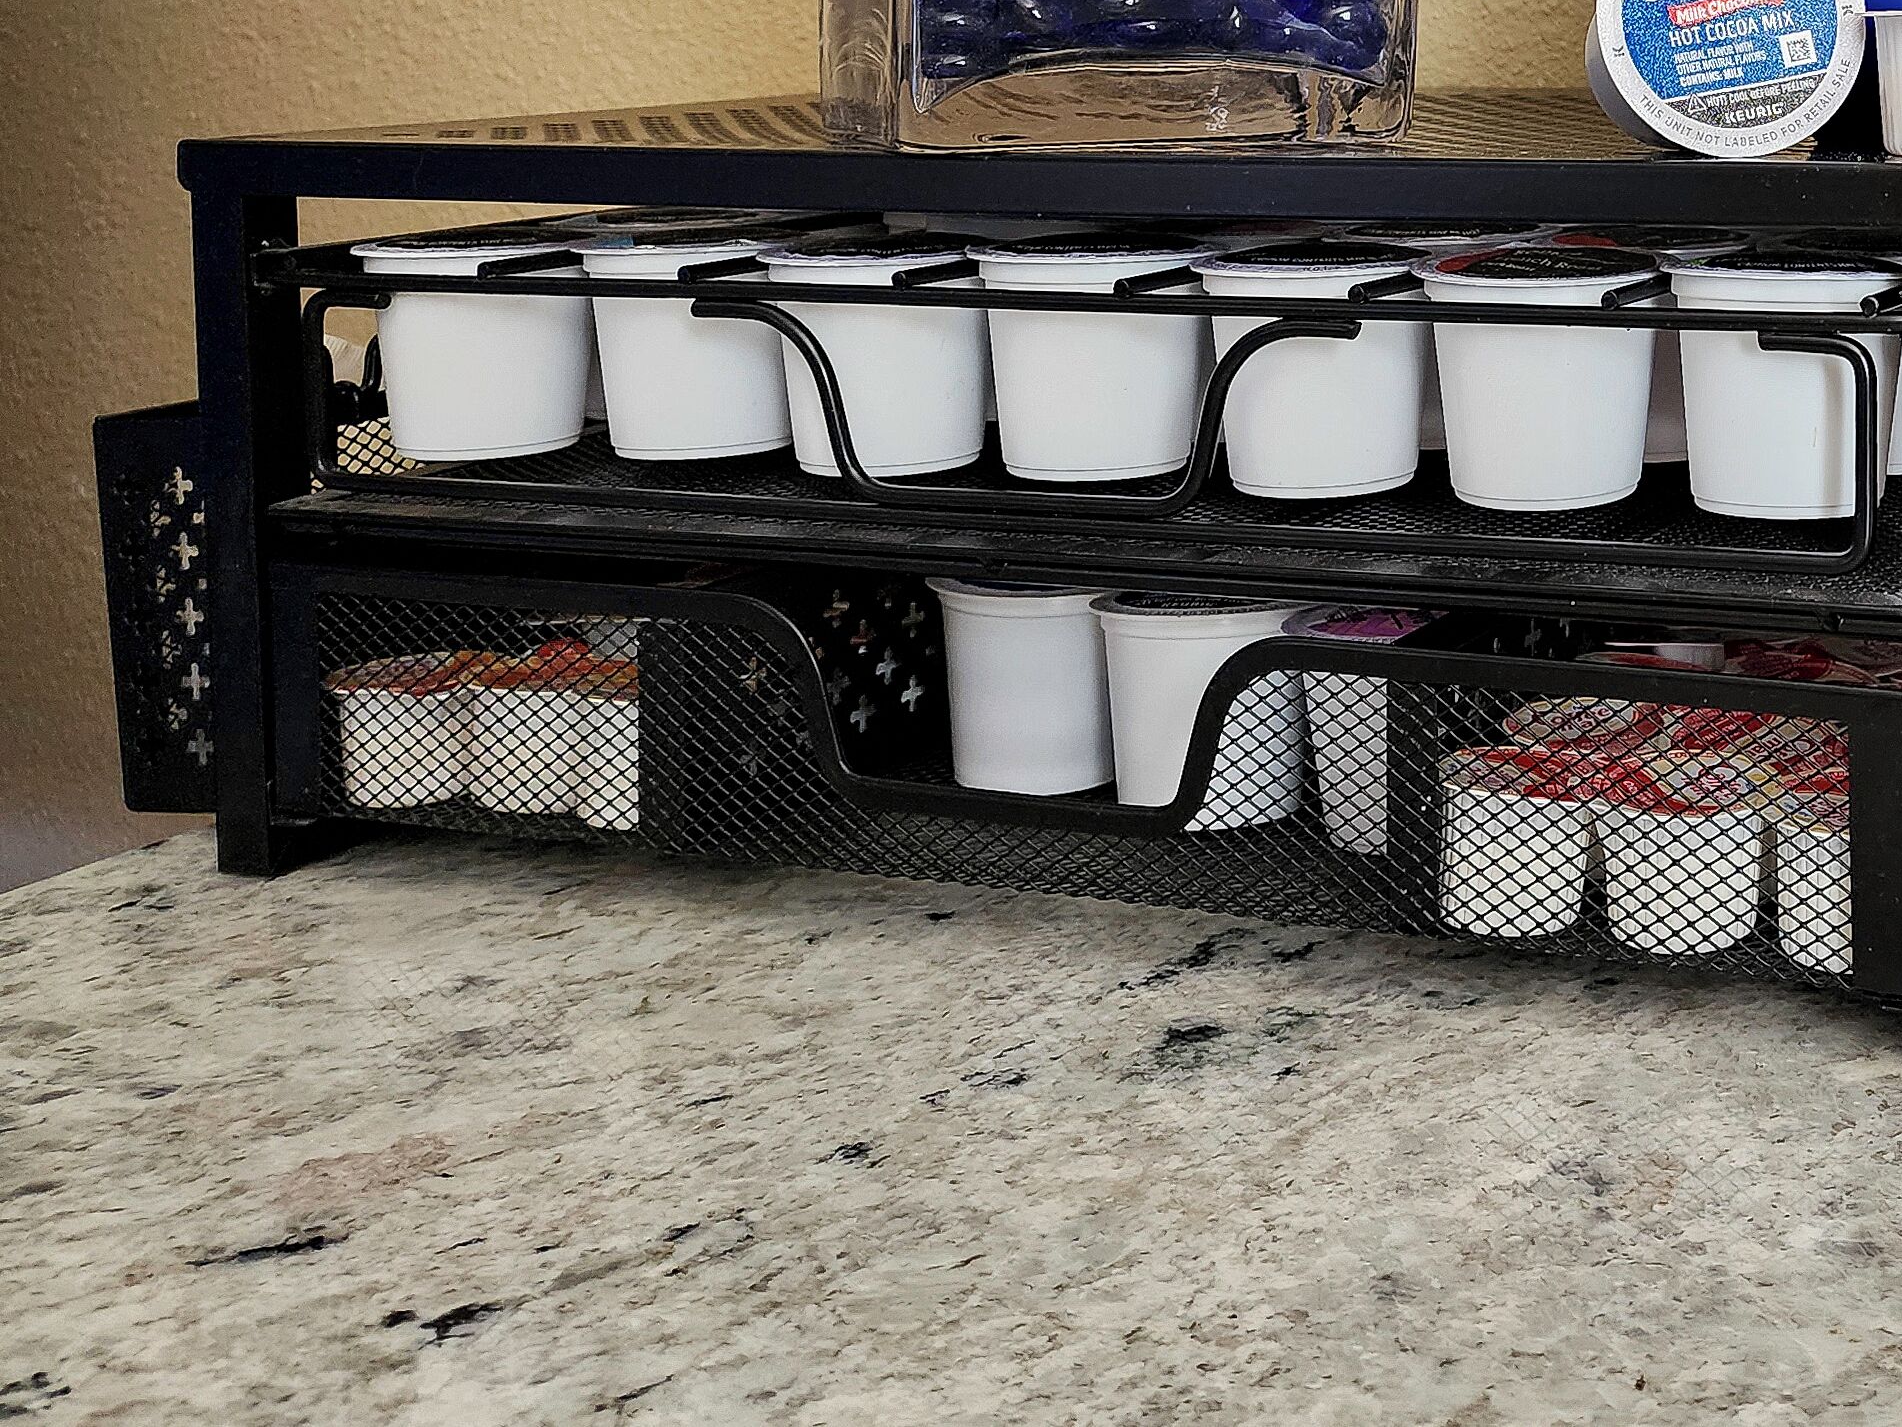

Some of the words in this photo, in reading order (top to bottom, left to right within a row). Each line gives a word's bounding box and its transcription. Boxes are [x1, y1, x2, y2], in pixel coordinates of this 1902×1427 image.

[1675, 5, 1707, 25] Milk
[1668, 26, 1702, 48] HOT
[1705, 18, 1760, 43] COCOA
[1761, 10, 1796, 32] MIX
[1675, 60, 1702, 74] OTHER
[1702, 55, 1734, 72] NATURAL
[1750, 84, 1782, 100] BEFORE
[1781, 76, 1818, 94] PEELING
[1639, 94, 1663, 119] THIS
[1664, 115, 1694, 137] UNIT
[1696, 131, 1721, 146] NOT
[1724, 130, 1779, 148] LABELED
[1780, 119, 1807, 138] FOR
[1804, 90, 1837, 123] RETAIL
[1832, 58, 1852, 88] SALE
[1723, 105, 1783, 125] KEURIG
